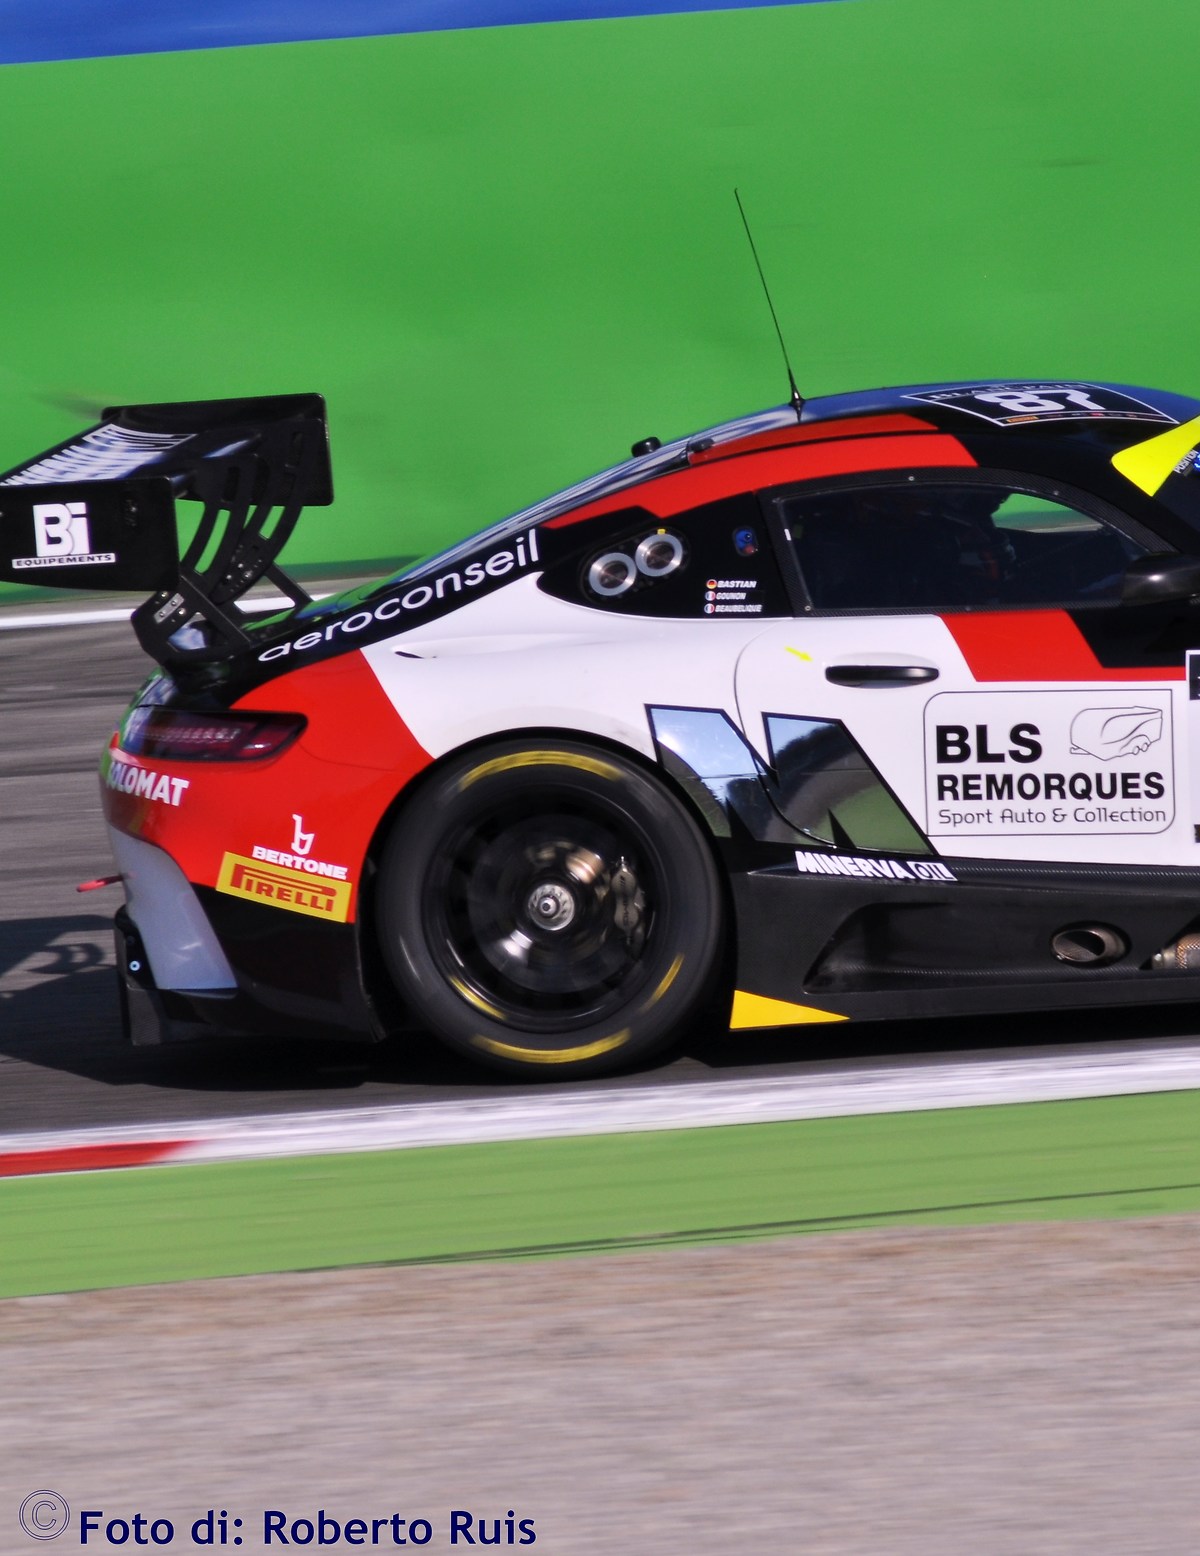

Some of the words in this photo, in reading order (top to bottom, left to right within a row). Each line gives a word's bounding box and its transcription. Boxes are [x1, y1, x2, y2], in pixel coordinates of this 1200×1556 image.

[973, 389, 1106, 413] 87
[16, 554, 112, 567] EQUIPEMENTS
[258, 528, 539, 662] aeroconseil
[717, 580, 757, 588] BASTIAN
[936, 723, 1043, 764] BLS
[937, 772, 1165, 802] REMORQUES
[939, 808, 993, 827] Sport
[1000, 809, 1046, 823] Auto
[1073, 807, 1167, 823] Collection
[252, 845, 348, 880] BERTONE
[795, 851, 915, 879] MINERVA
[914, 862, 954, 880] OIL
[230, 863, 337, 912] PIRELLI
